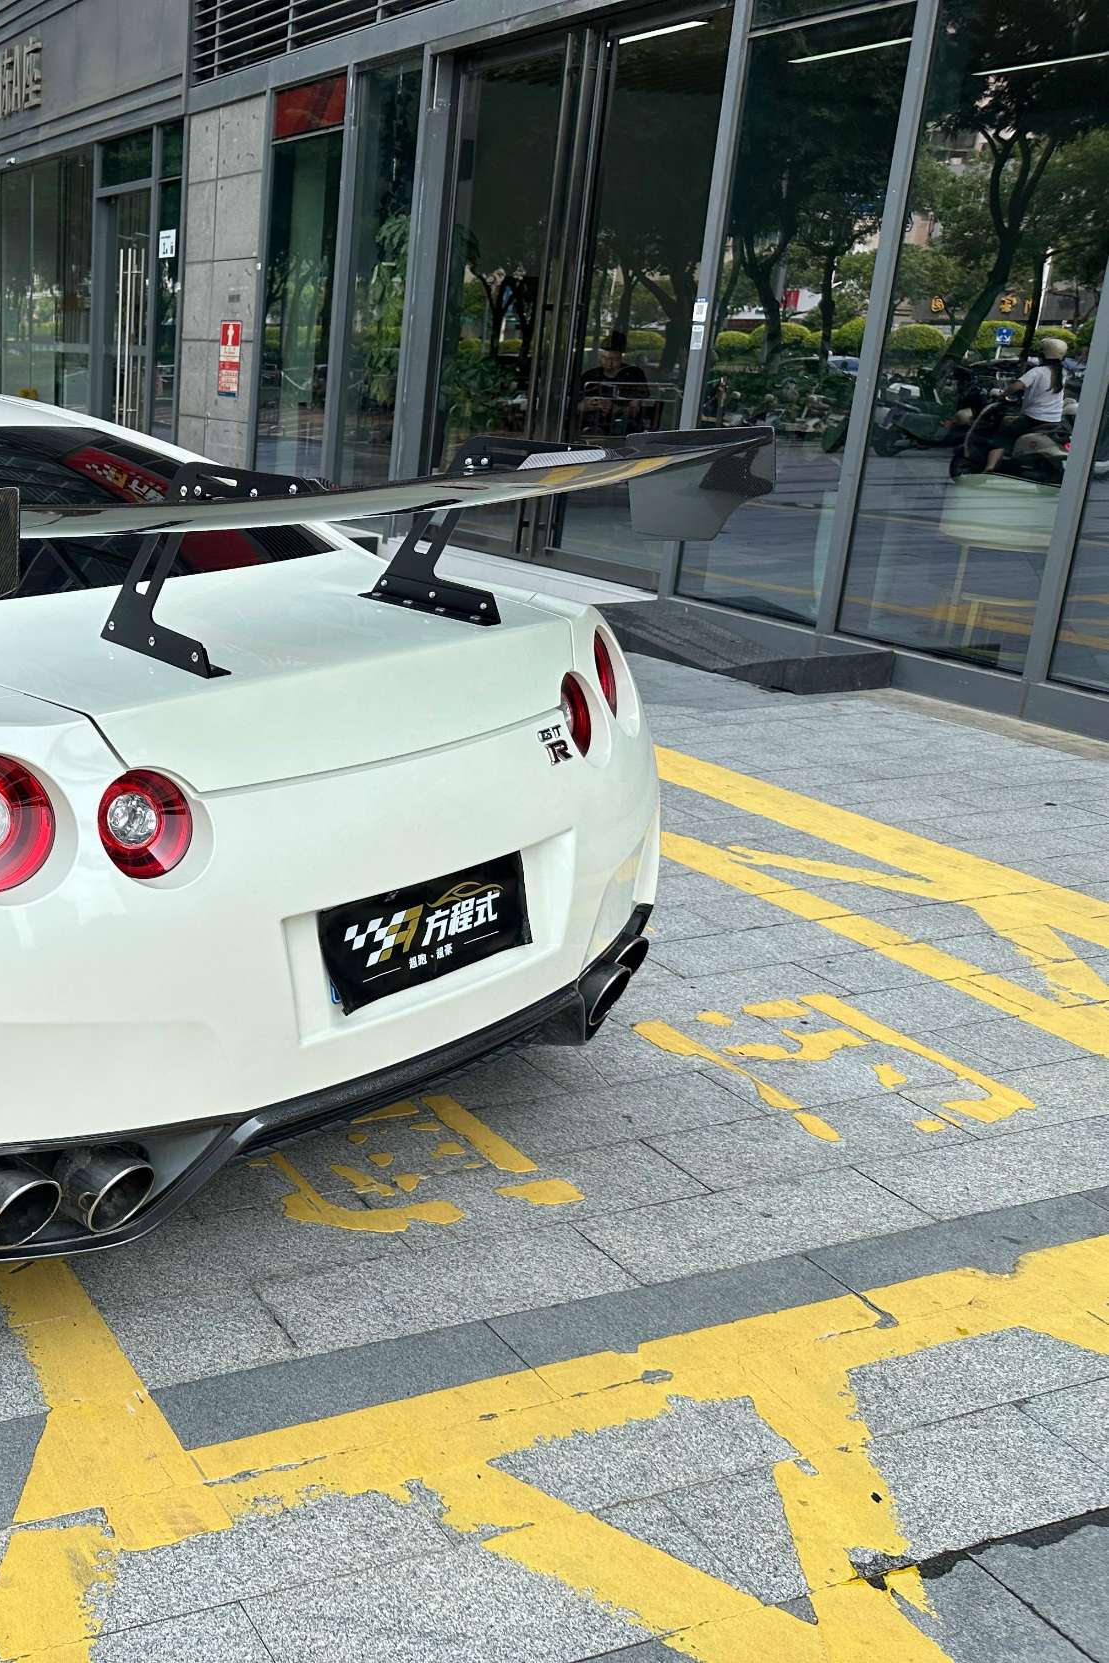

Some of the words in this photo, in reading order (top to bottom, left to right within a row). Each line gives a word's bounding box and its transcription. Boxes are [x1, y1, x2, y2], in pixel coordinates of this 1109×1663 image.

[537, 723, 562, 742] GT
[544, 739, 574, 766] R
[421, 890, 501, 947] 方程式
